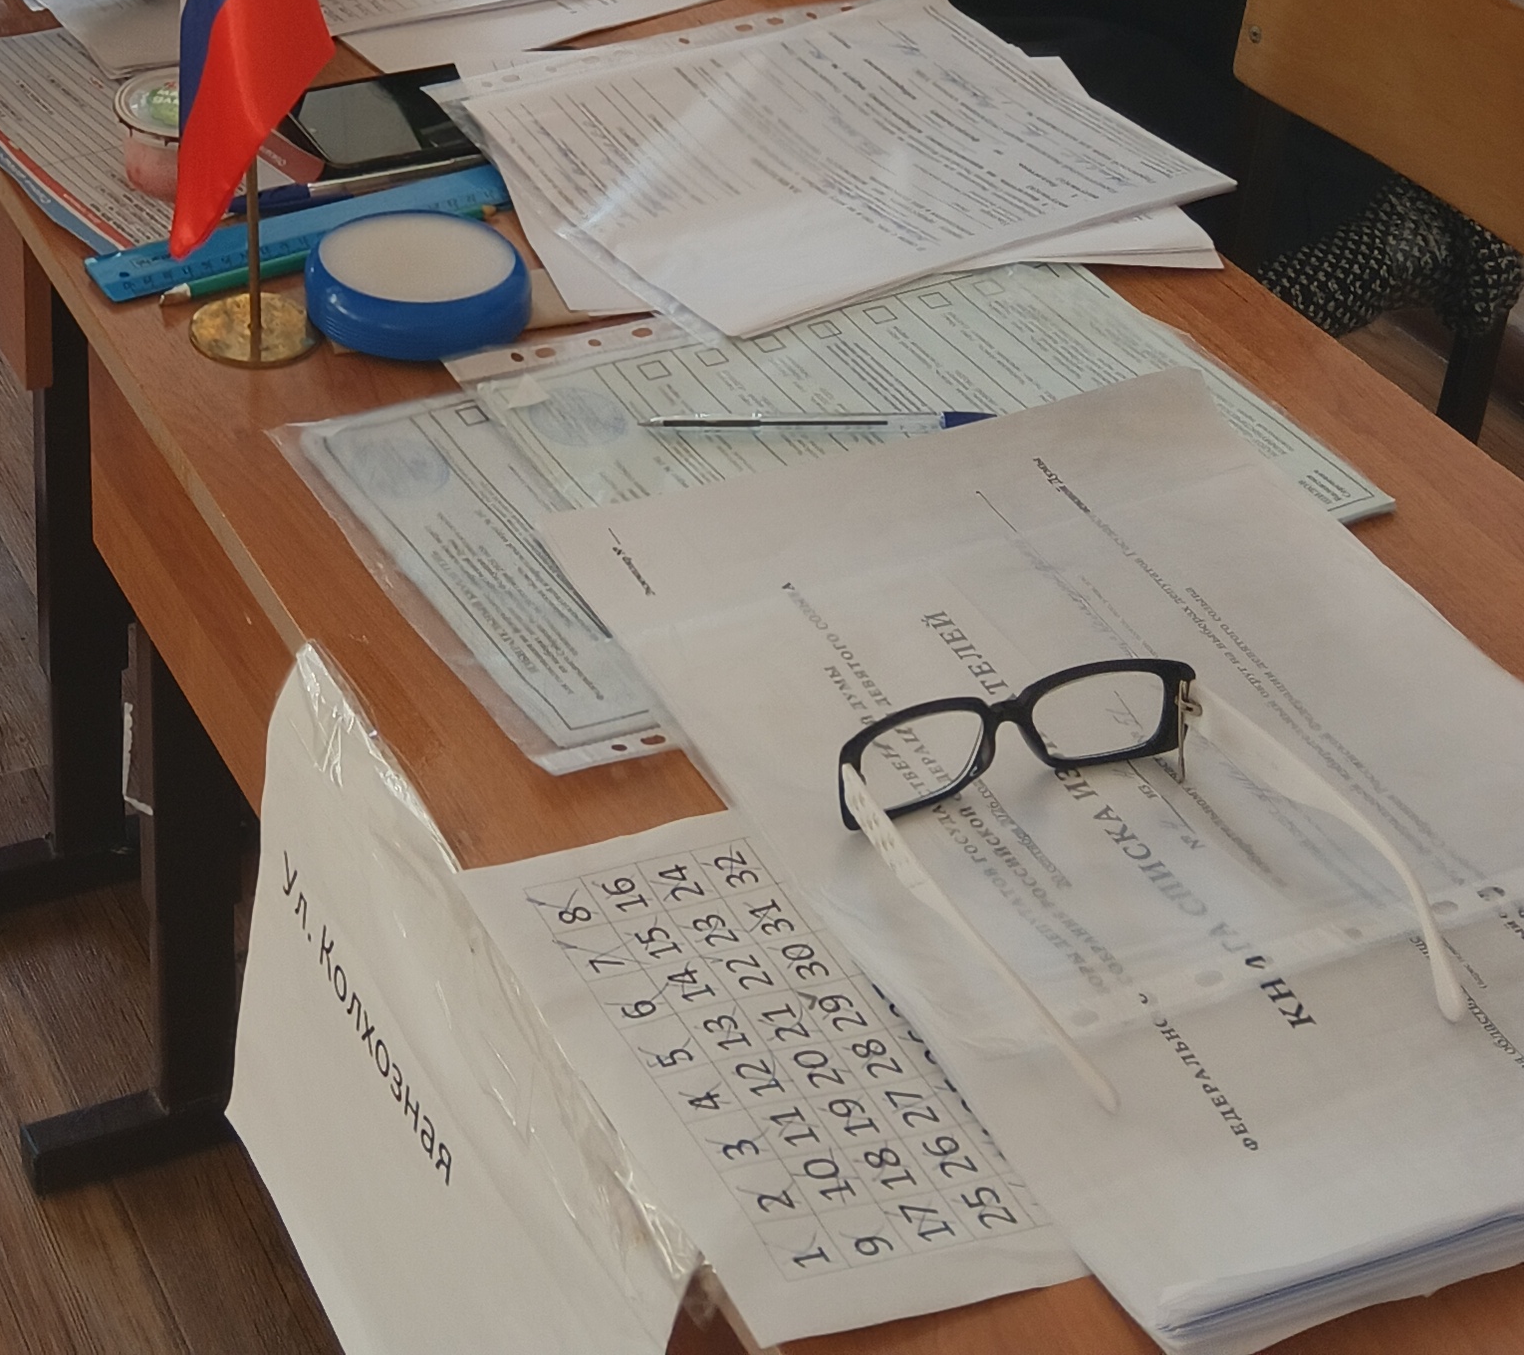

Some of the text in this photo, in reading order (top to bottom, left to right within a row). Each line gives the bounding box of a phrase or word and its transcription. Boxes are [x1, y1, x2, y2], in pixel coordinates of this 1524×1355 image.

[1029, 455, 1063, 486] Думы
[1132, 555, 1185, 607] депутатов
[1183, 585, 1223, 624] созыва
[1178, 604, 1228, 653] выборах
[1218, 621, 1268, 672] девятого
[1221, 651, 1239, 666] на
[819, 663, 869, 712] ДУМЫ
[821, 632, 894, 708] ДЕВЯТОГО
[1234, 664, 1273, 700] округ
[919, 608, 1100, 804] ИЗТЕЛЕЙ
[1136, 782, 1160, 801] из
[956, 804, 1056, 911] РОССИЙСКОЙ
[1090, 803, 1210, 922] СПИСКА
[279, 850, 457, 1187] ул. Колхозная
[714, 850, 1017, 1229] 25 26 27 28 29 30 31 32
[602, 878, 895, 1255] 9 10 11 12 13 14 15 16
[659, 864, 955, 1241] 17 18 19 20 21 22 23 24
[558, 906, 831, 1268] 1 2 3 4 5 6 7 8
